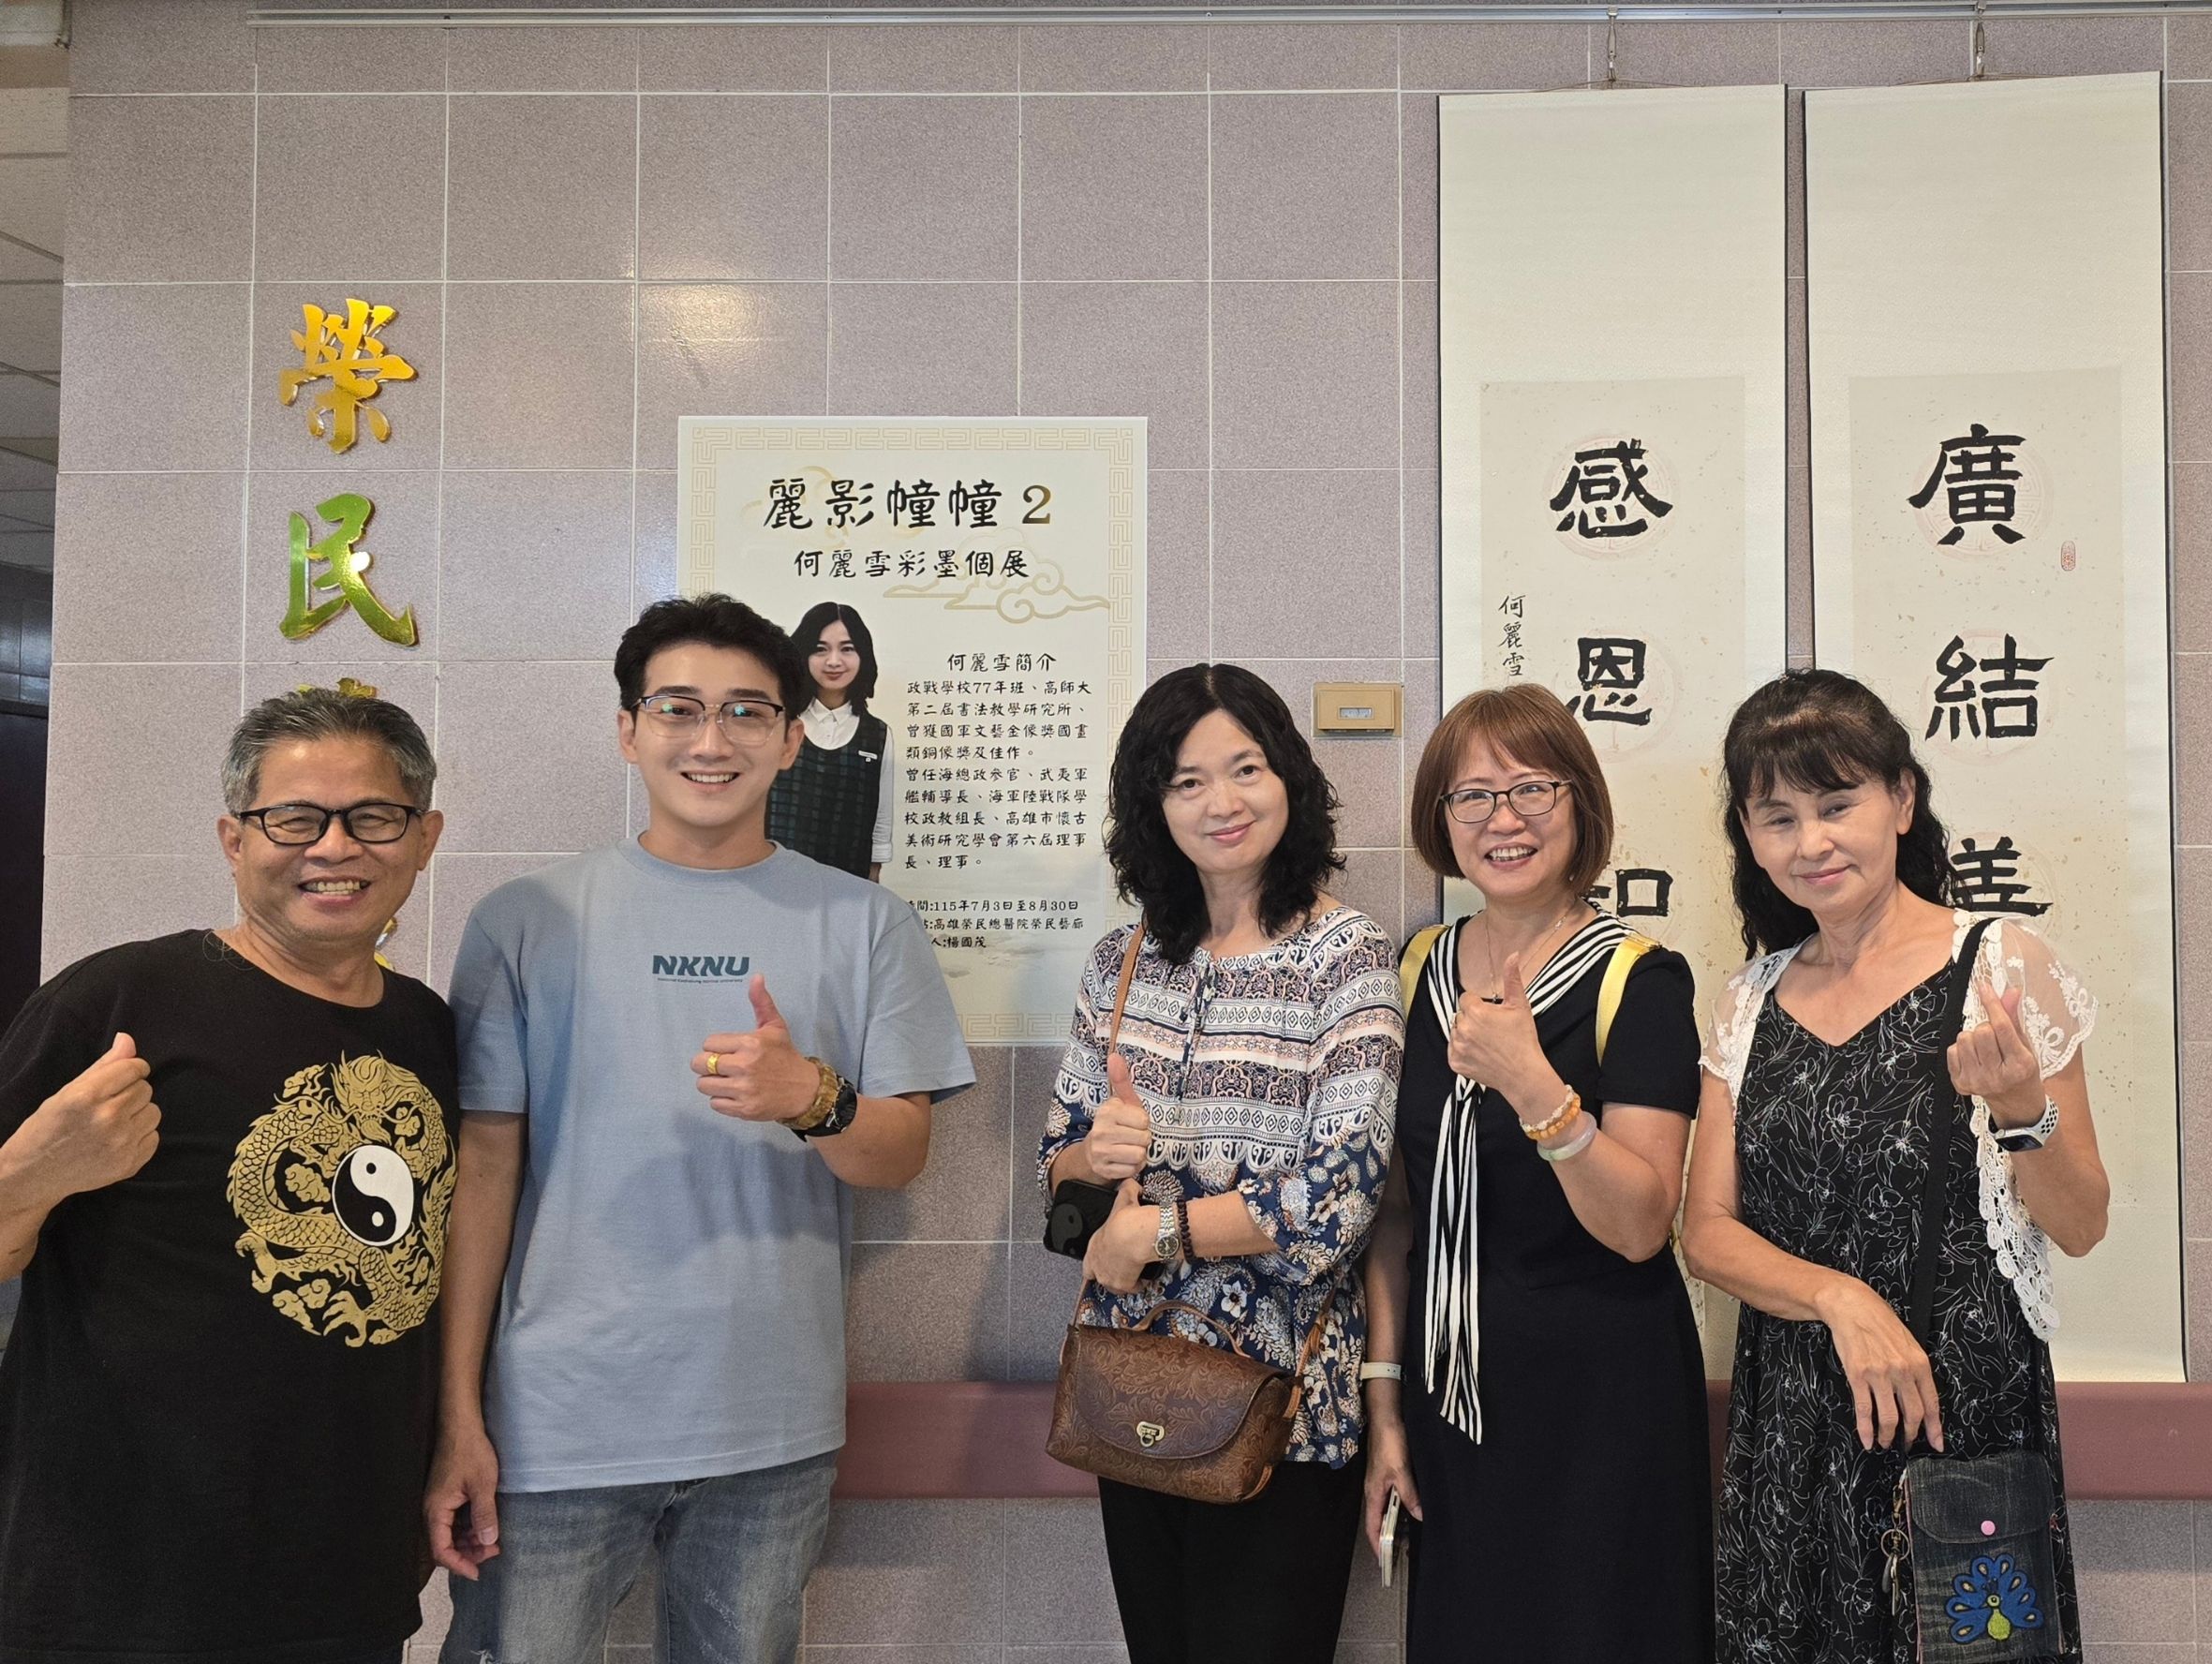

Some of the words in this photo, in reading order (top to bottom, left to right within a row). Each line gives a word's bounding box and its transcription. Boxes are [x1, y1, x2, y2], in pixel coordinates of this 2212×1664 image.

[764, 478, 1002, 529] 麗影幢幢
[1022, 484, 1050, 525] 2
[794, 549, 1030, 579] 何麗雪彩墨個展
[1498, 594, 1526, 676] 何麗雪
[947, 652, 1057, 673] 何麗雪簡介
[907, 679, 1092, 695] 政戰學校77年班、高師大
[905, 832, 1086, 848] 美術研究學會第六屆理事
[904, 854, 982, 869] 長、理事。
[909, 899, 1078, 913] 間:115年7月3日至8月30日
[652, 955, 750, 977] NKNU
